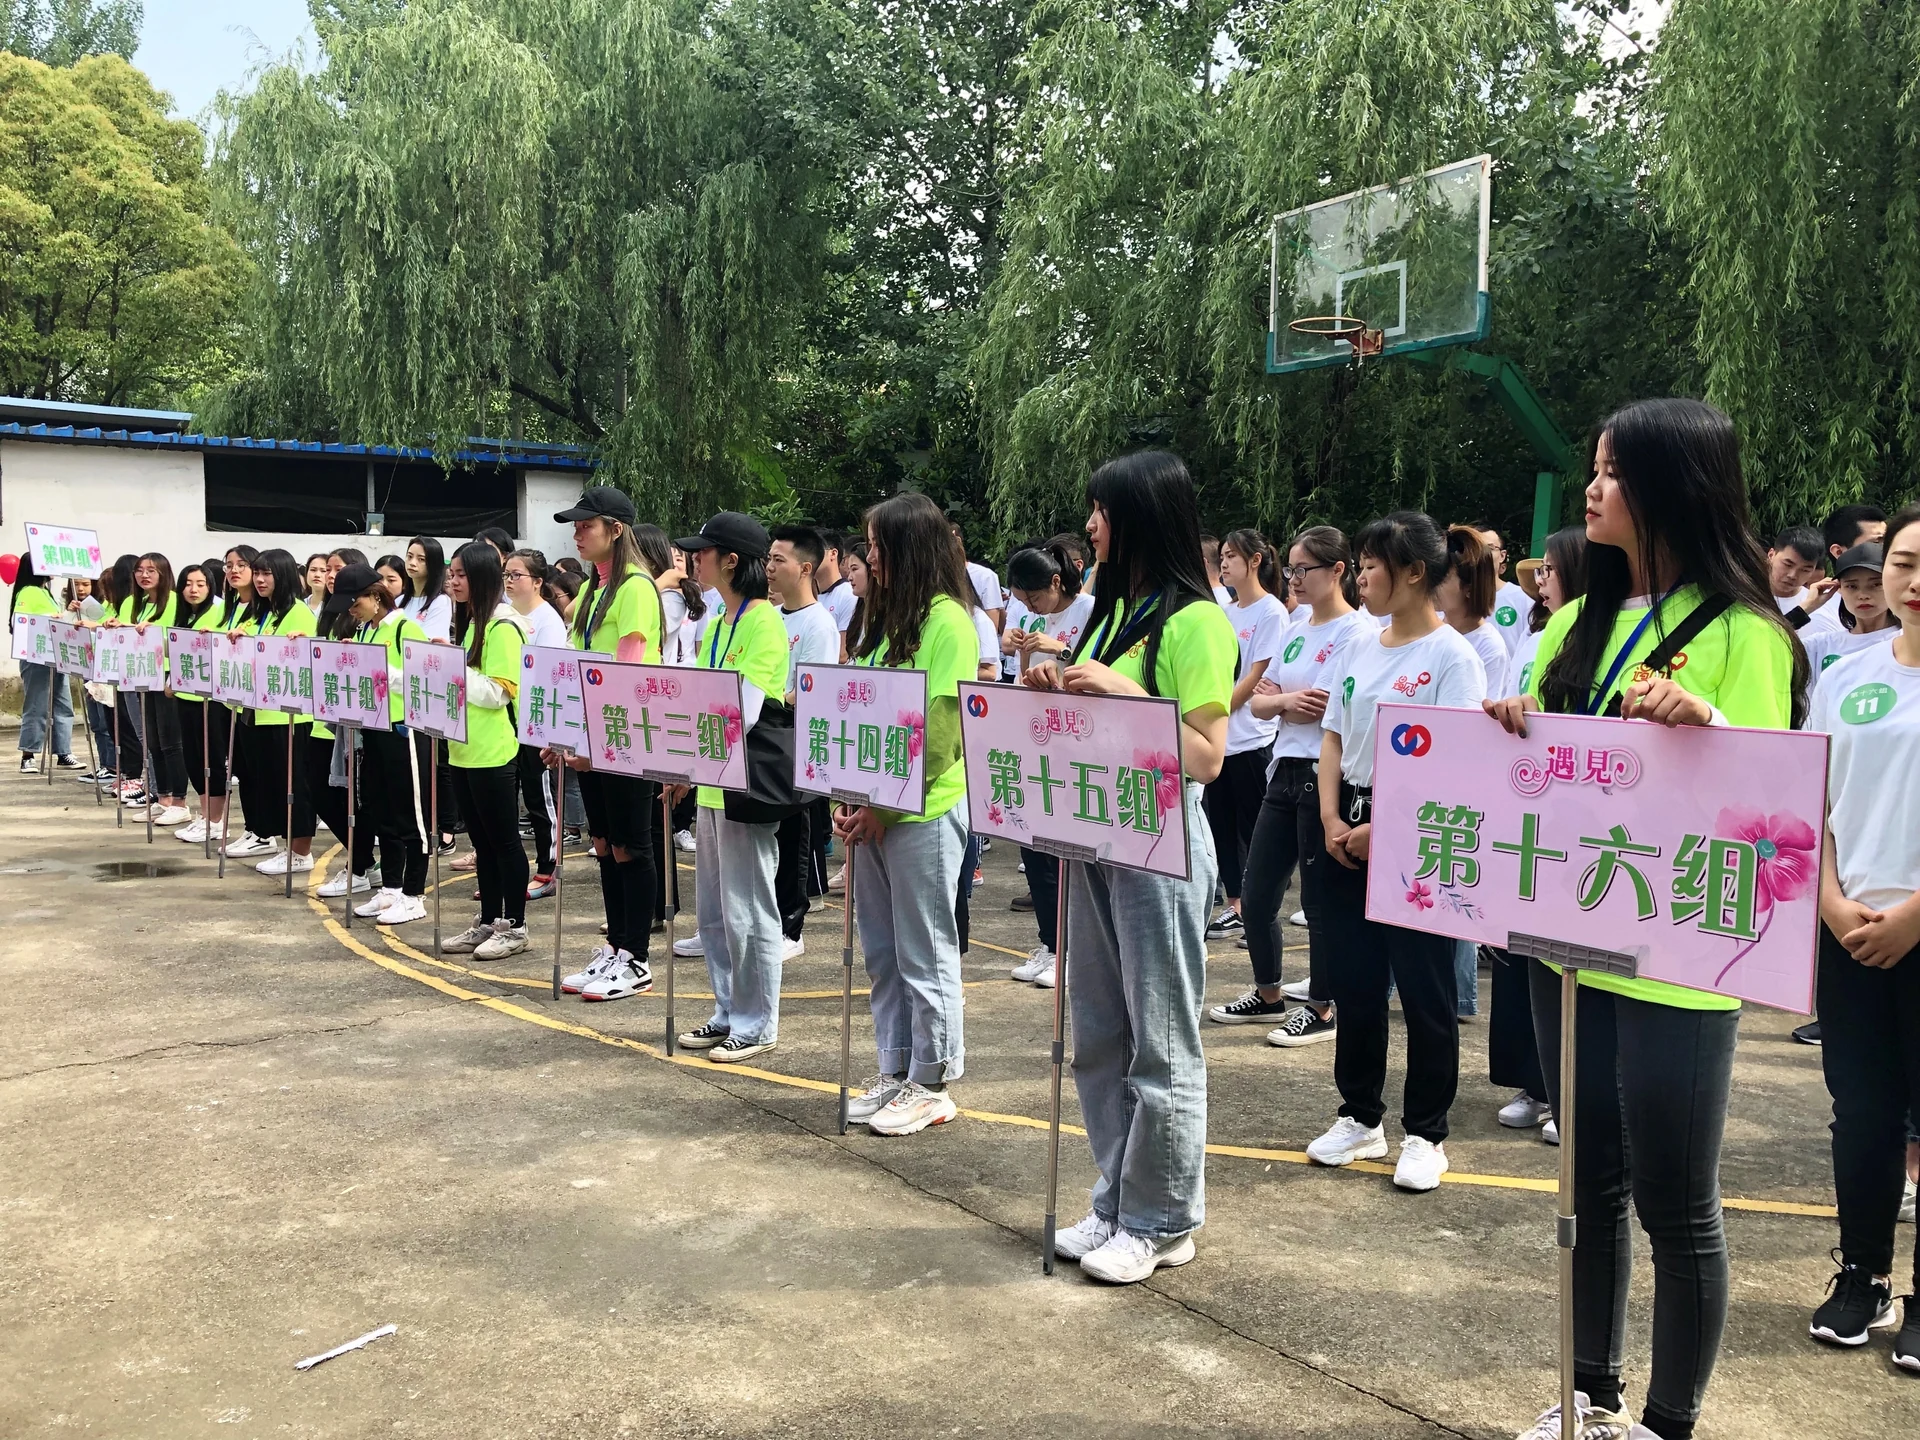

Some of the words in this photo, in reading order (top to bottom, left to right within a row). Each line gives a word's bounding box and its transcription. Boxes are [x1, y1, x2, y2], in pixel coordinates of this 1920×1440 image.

[42, 544, 92, 569] 第四组
[59, 641, 89, 669] 第三组
[126, 651, 157, 678] 第六组
[180, 653, 210, 682] 第七
[220, 659, 254, 692] 第八组
[267, 665, 312, 699] 第九组
[323, 672, 377, 712] 第十组
[410, 674, 459, 722] 第十一组
[529, 685, 587, 734] 第十二
[1855, 697, 1879, 716] 11
[601, 704, 730, 762] 第十三组
[1045, 708, 1079, 734] 遇見
[808, 716, 910, 780] 第十四组
[1545, 744, 1612, 785] 遇見
[986, 748, 1162, 837] 第十五组
[1415, 800, 1761, 942] 第十六组
